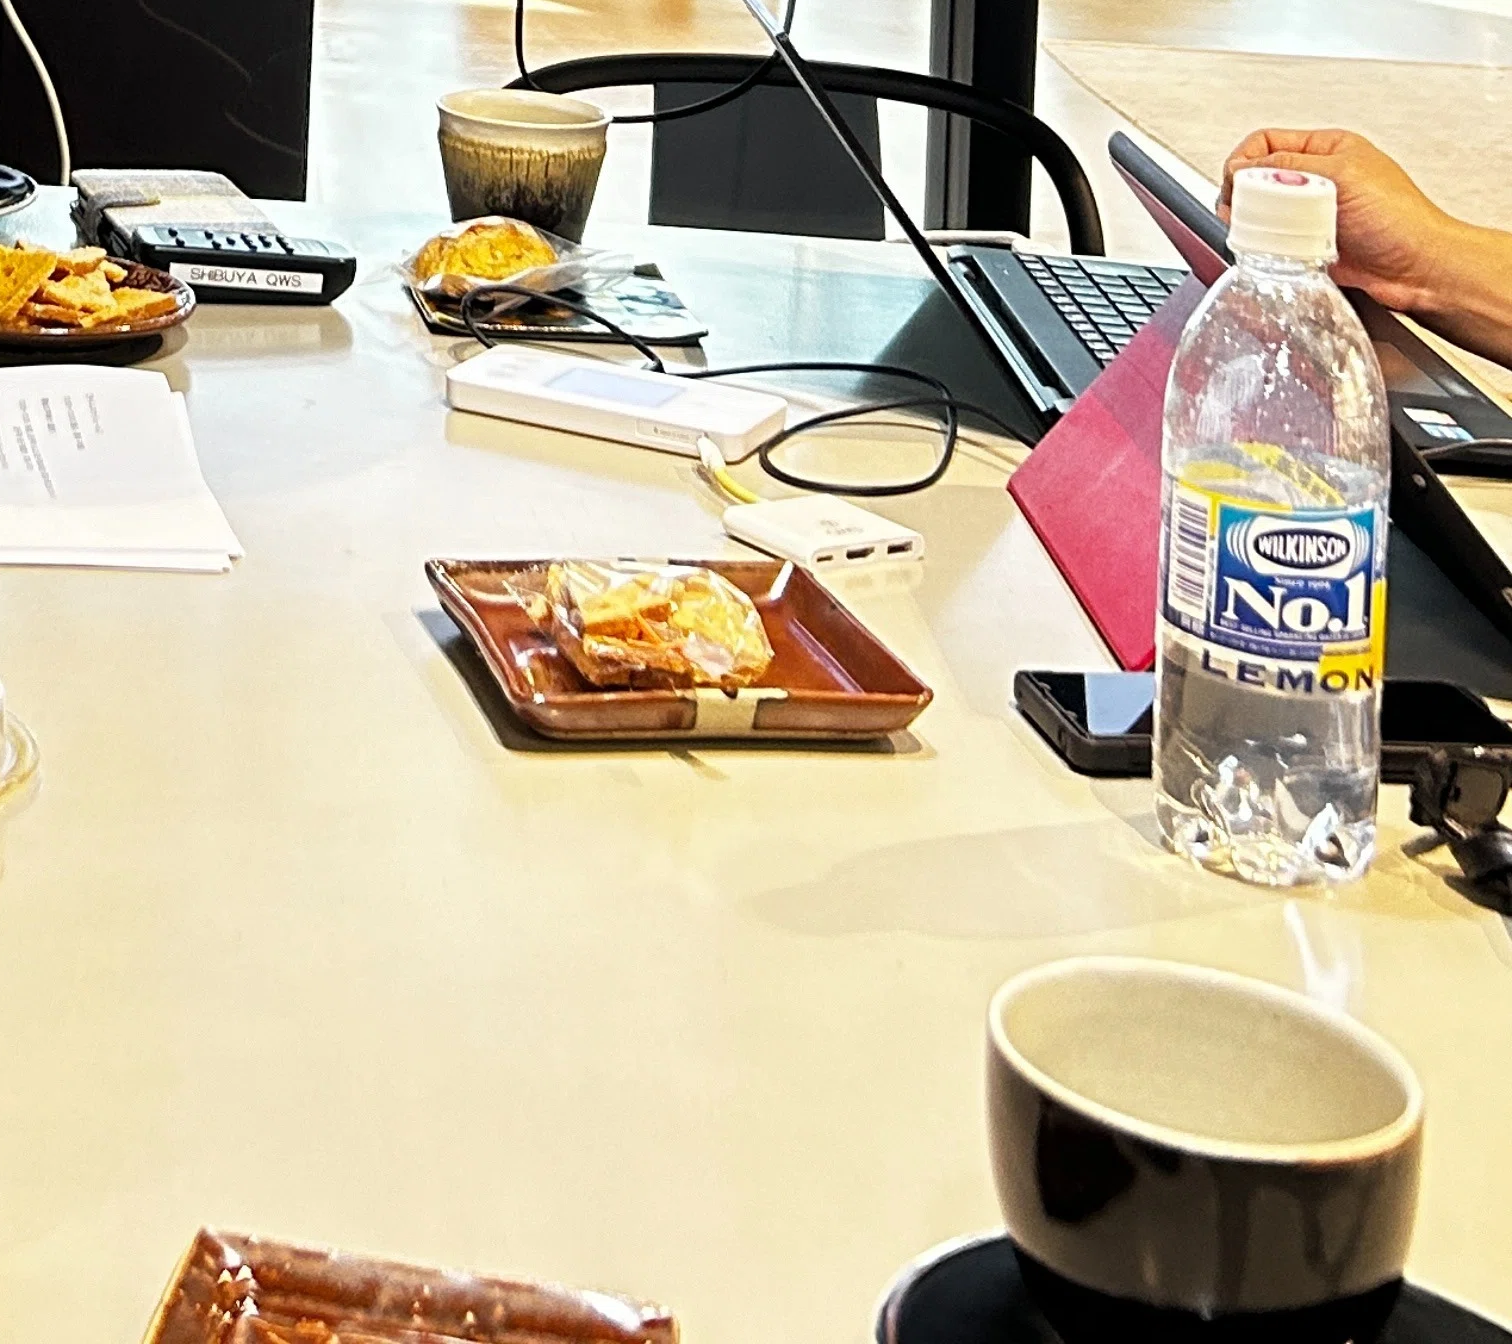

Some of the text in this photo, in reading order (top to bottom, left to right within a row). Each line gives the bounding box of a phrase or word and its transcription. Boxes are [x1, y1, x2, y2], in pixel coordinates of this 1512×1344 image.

[190, 267, 302, 288] SHIBUYA QWS
[1257, 534, 1347, 563] WILKINSON
[1220, 571, 1368, 633] No.1
[1202, 648, 1375, 694] LEMON
